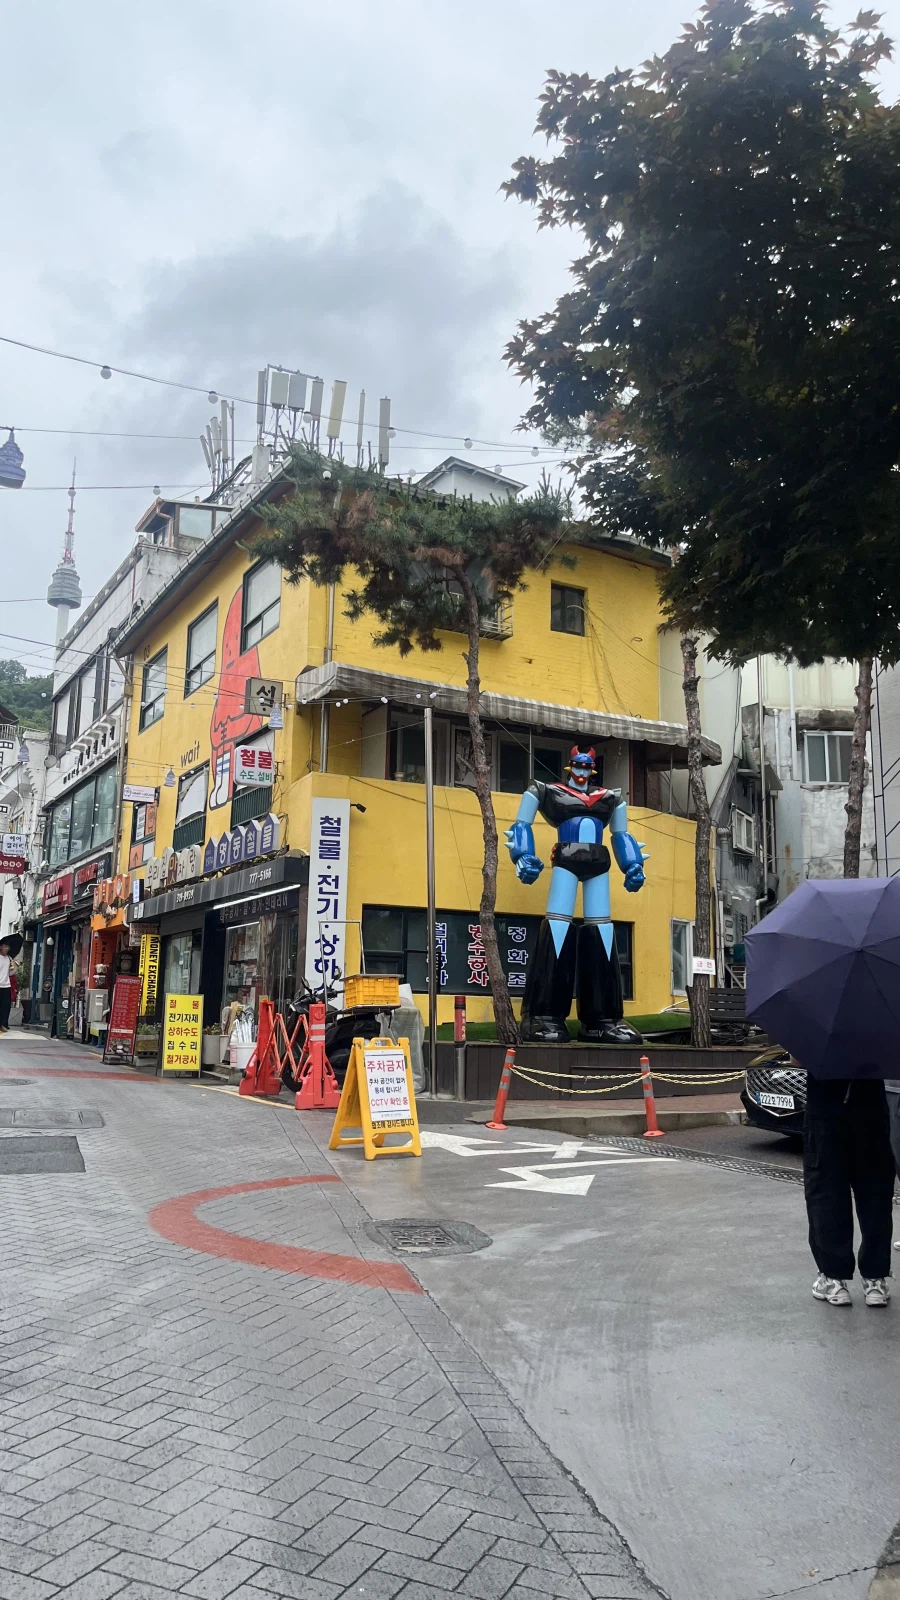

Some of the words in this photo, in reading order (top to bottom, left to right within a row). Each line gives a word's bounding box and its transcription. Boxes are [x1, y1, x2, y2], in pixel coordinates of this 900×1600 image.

[180, 740, 200, 768] wait
[240, 748, 272, 769] 철물
[149, 936, 160, 964] MONEY
[507, 926, 529, 988] 정화조
[167, 1027, 198, 1037] 상하수도
[166, 1054, 197, 1065] 철거공사
[367, 1059, 405, 1072] 주차금지
[371, 1098, 389, 1107] CCTV
[777, 1096, 793, 1108] 7996
